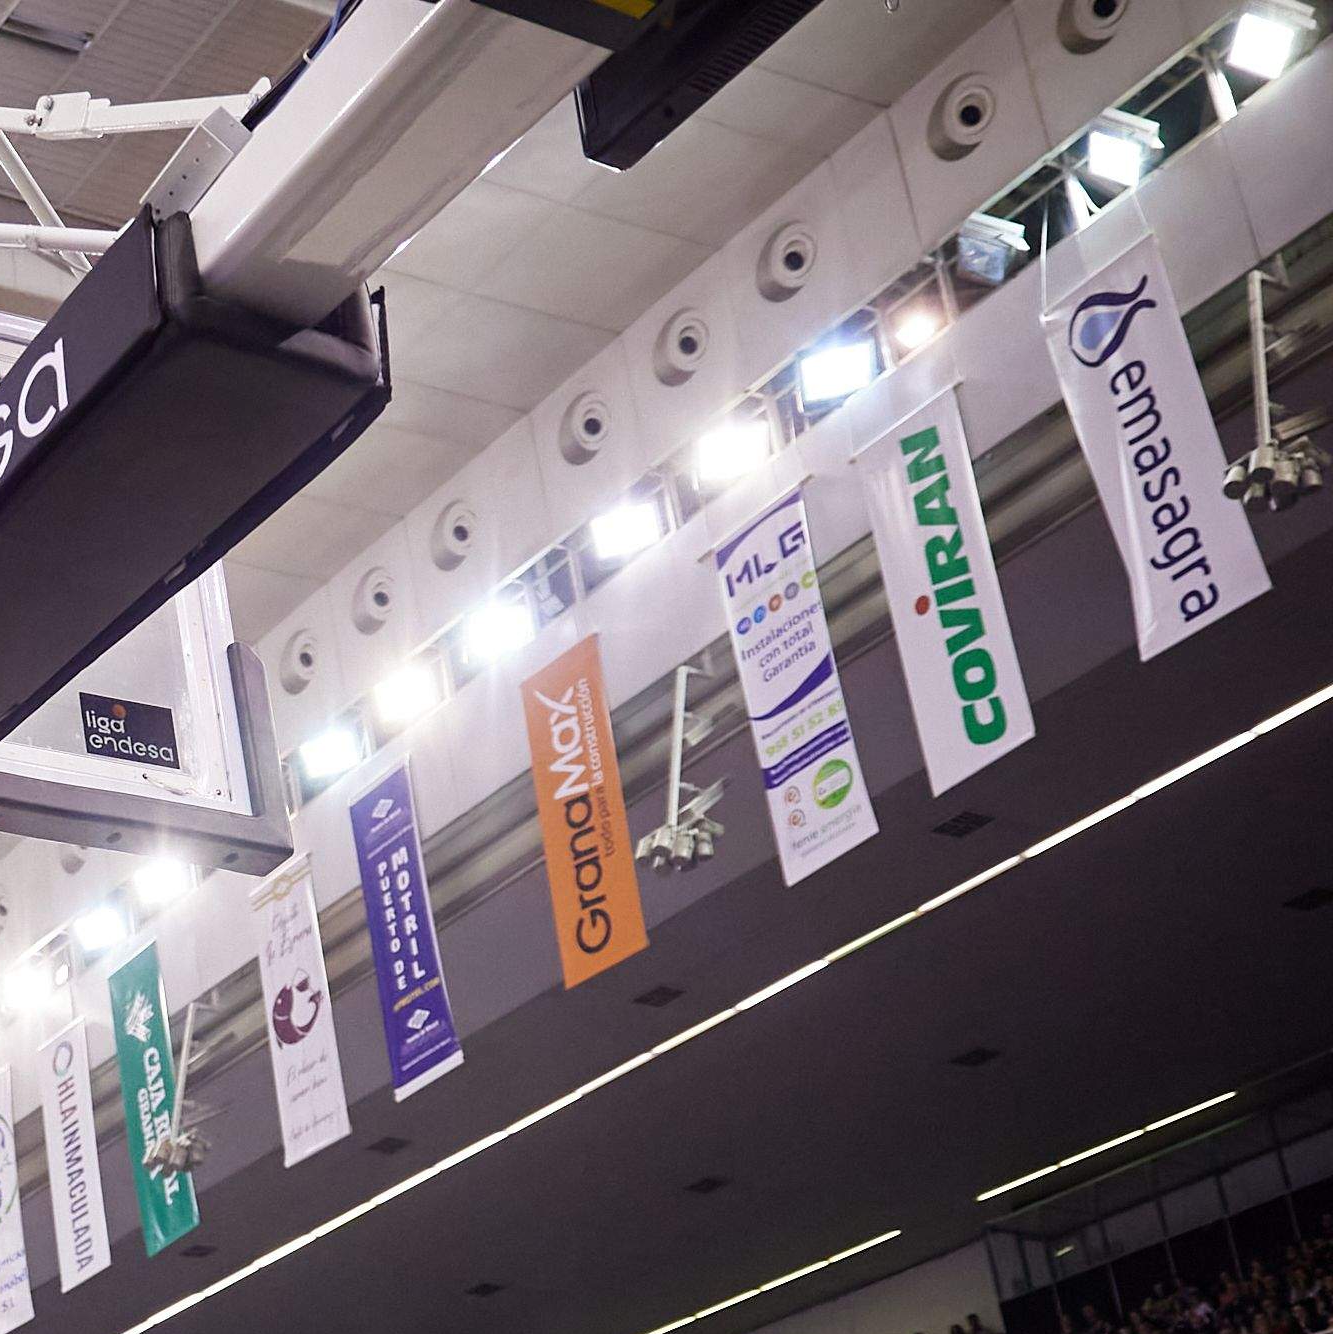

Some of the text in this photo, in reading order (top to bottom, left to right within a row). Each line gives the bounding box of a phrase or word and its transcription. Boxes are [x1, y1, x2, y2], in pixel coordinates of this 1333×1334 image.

[899, 425, 1008, 746] COVIRAN
[1109, 358, 1220, 623] emasagra
[85, 709, 126, 735] liga
[89, 733, 174, 763] endesa
[535, 684, 612, 954] GranaMax
